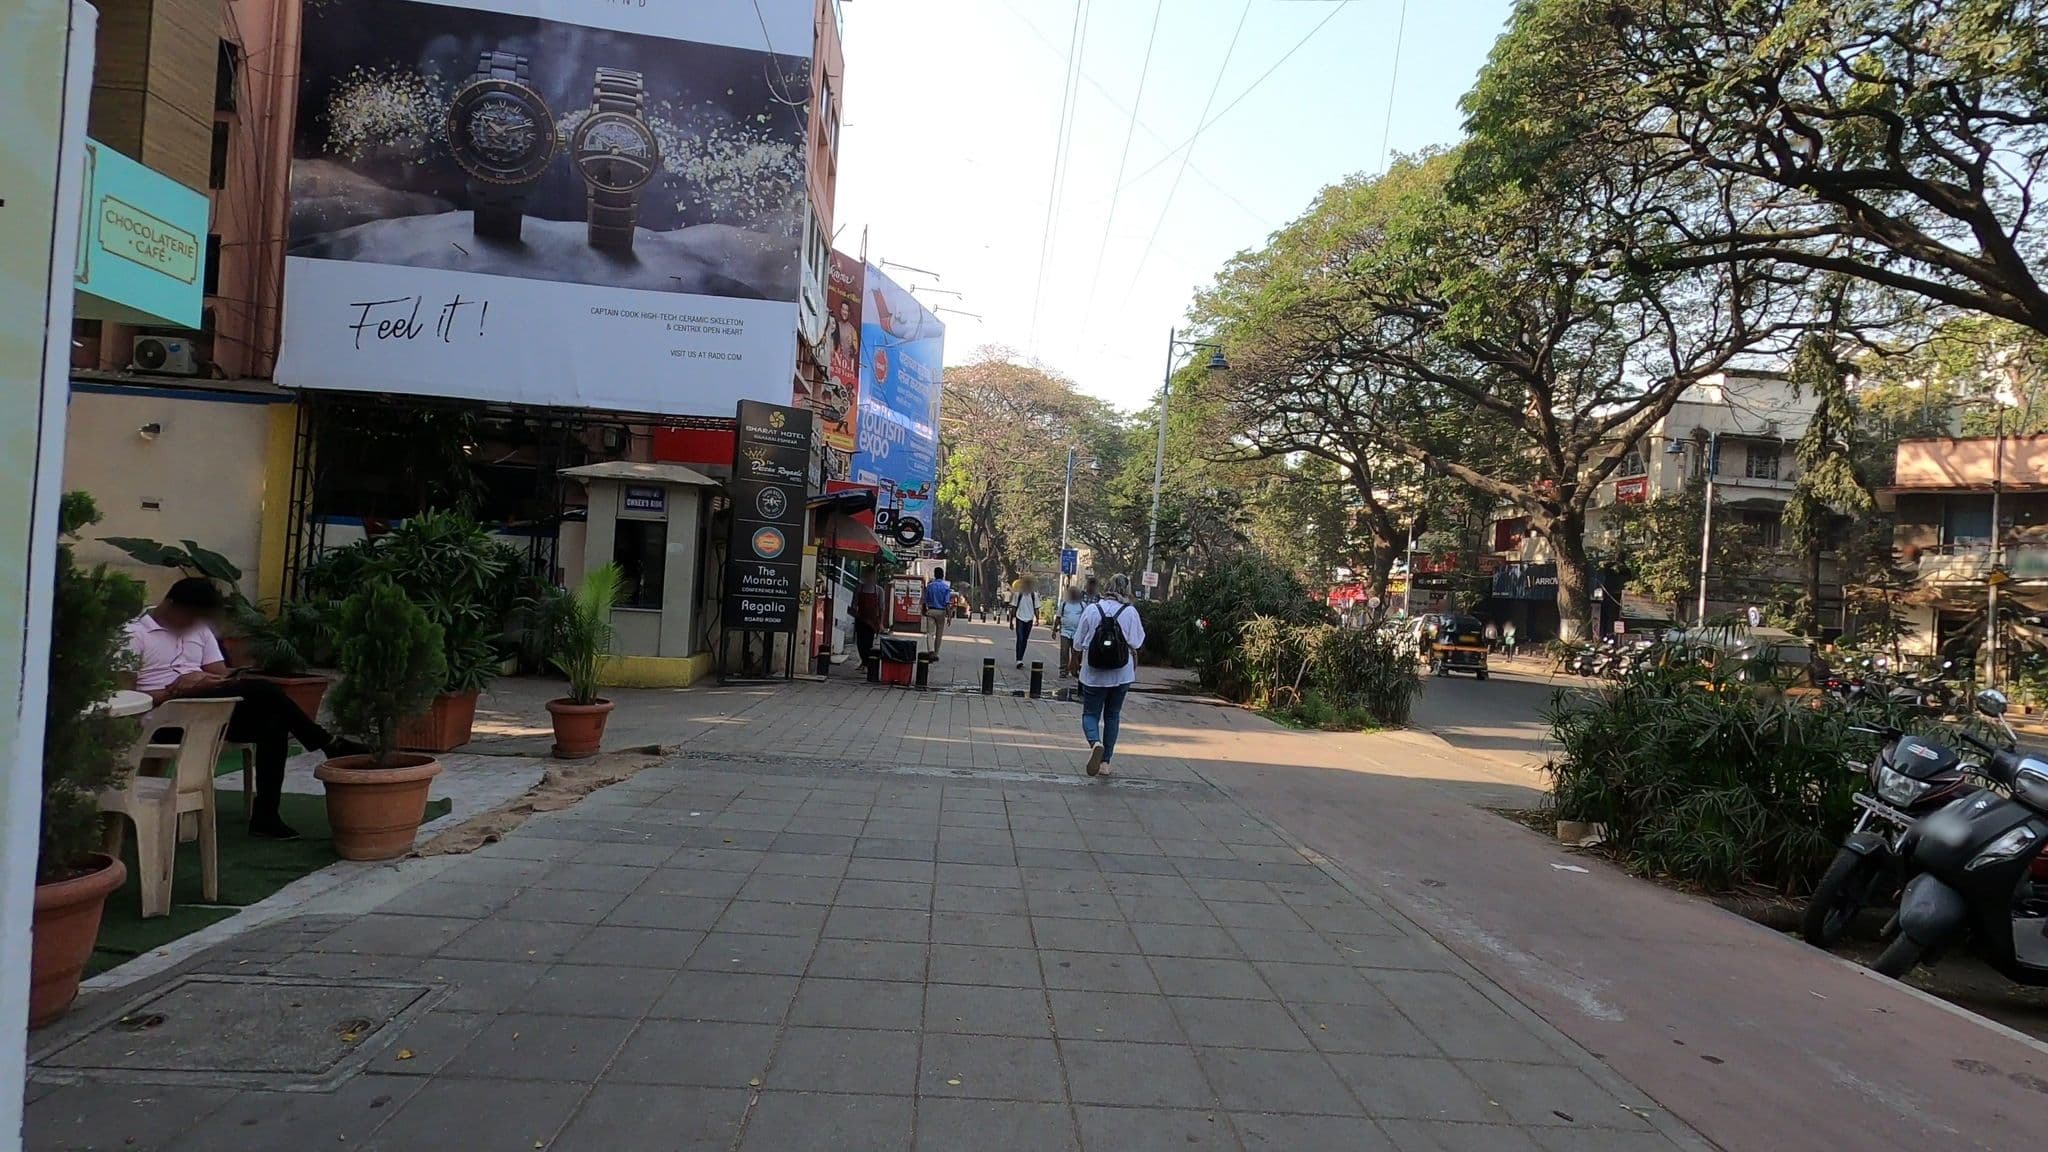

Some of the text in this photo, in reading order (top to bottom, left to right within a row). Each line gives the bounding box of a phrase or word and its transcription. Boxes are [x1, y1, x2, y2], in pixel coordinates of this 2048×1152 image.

[106, 210, 194, 259] CHOCOLATERIE
[136, 241, 166, 263] CAFÉ
[349, 296, 424, 350] Feel
[437, 294, 475, 343] it
[590, 307, 744, 327] CAPTAIN COOK HIGH-TECH CERAMIC SKELETON
[666, 323, 743, 336] & CENTRIX OPEN HEART
[670, 349, 742, 361] VISIT US AT RADO.COM
[745, 425, 806, 440] BHARAT HOTEL
[862, 408, 906, 445] tourism
[860, 430, 890, 463] expo
[758, 565, 776, 576] The
[742, 575, 789, 587] Monarch
[741, 599, 786, 615] Regalia
